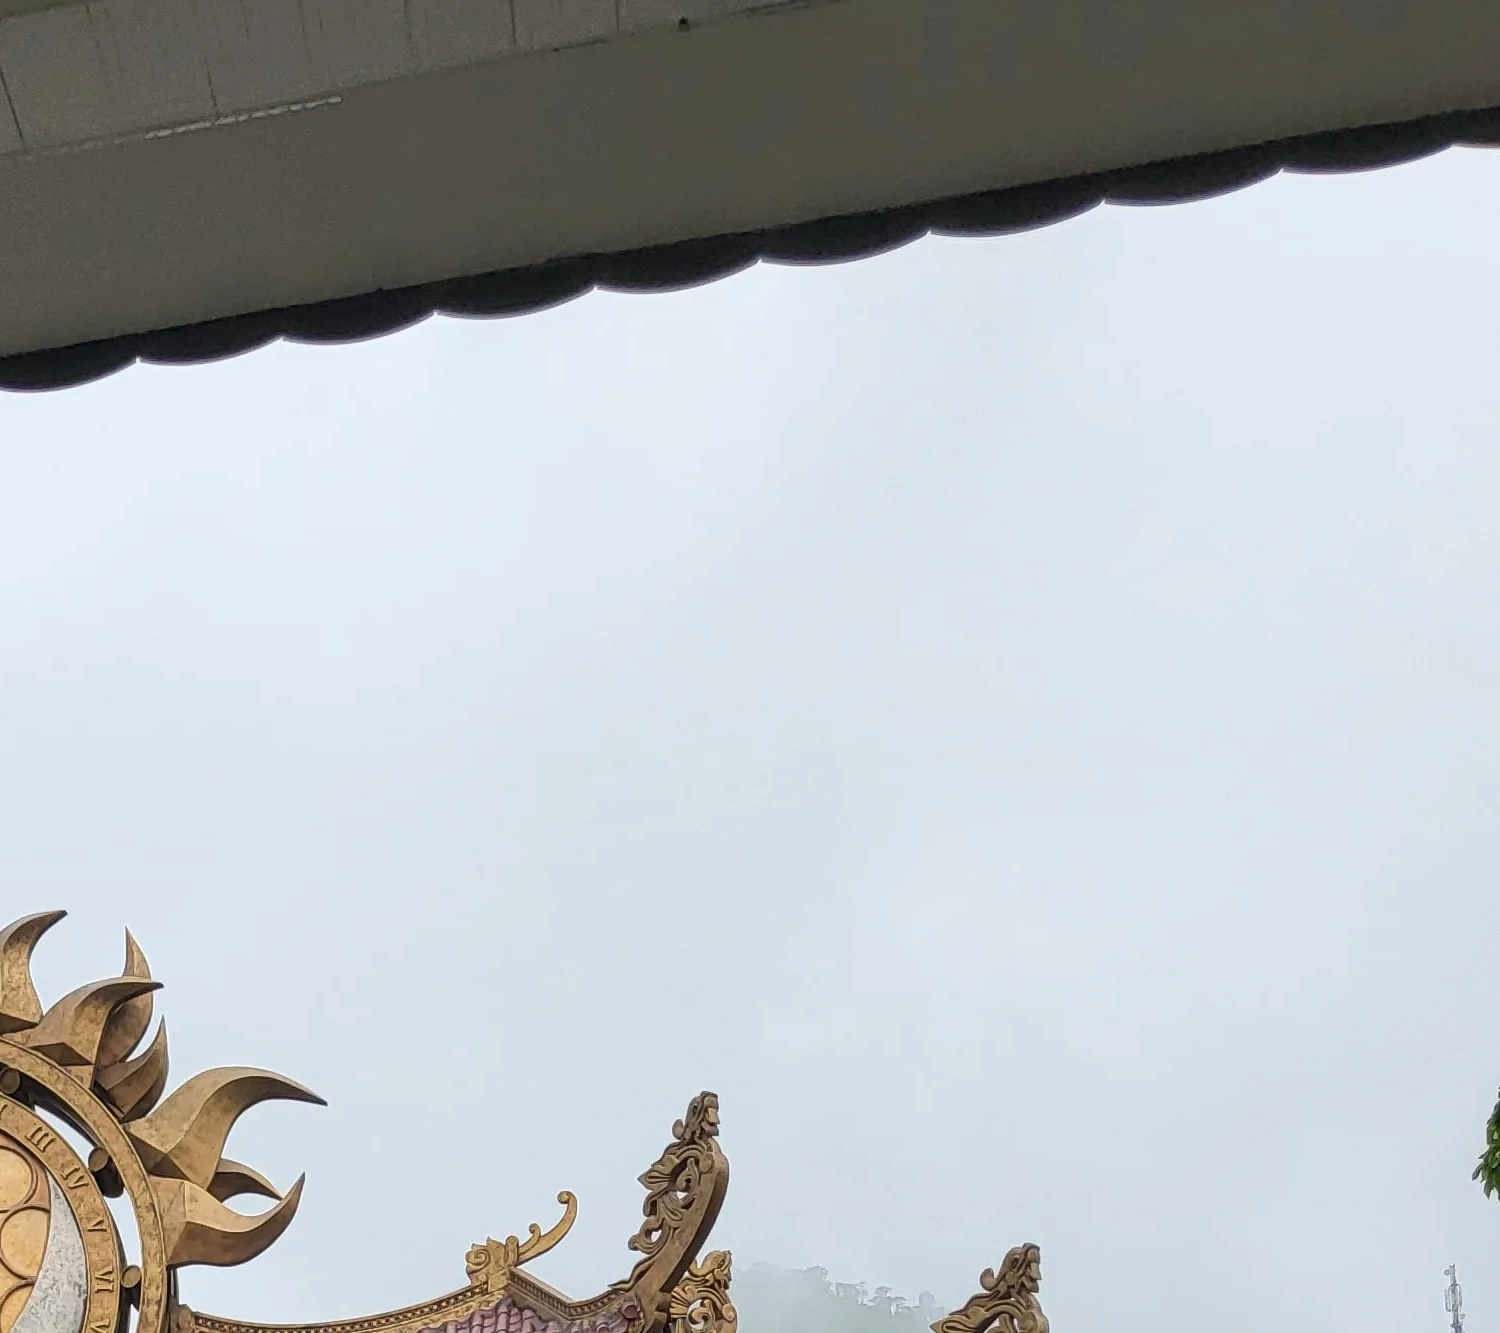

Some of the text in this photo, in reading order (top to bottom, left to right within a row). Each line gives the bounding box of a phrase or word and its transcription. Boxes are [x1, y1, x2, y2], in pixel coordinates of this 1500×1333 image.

[24, 1126, 56, 1153] III
[60, 1167, 89, 1190] IV
[87, 1219, 108, 1233] V
[95, 1266, 114, 1293] VI
